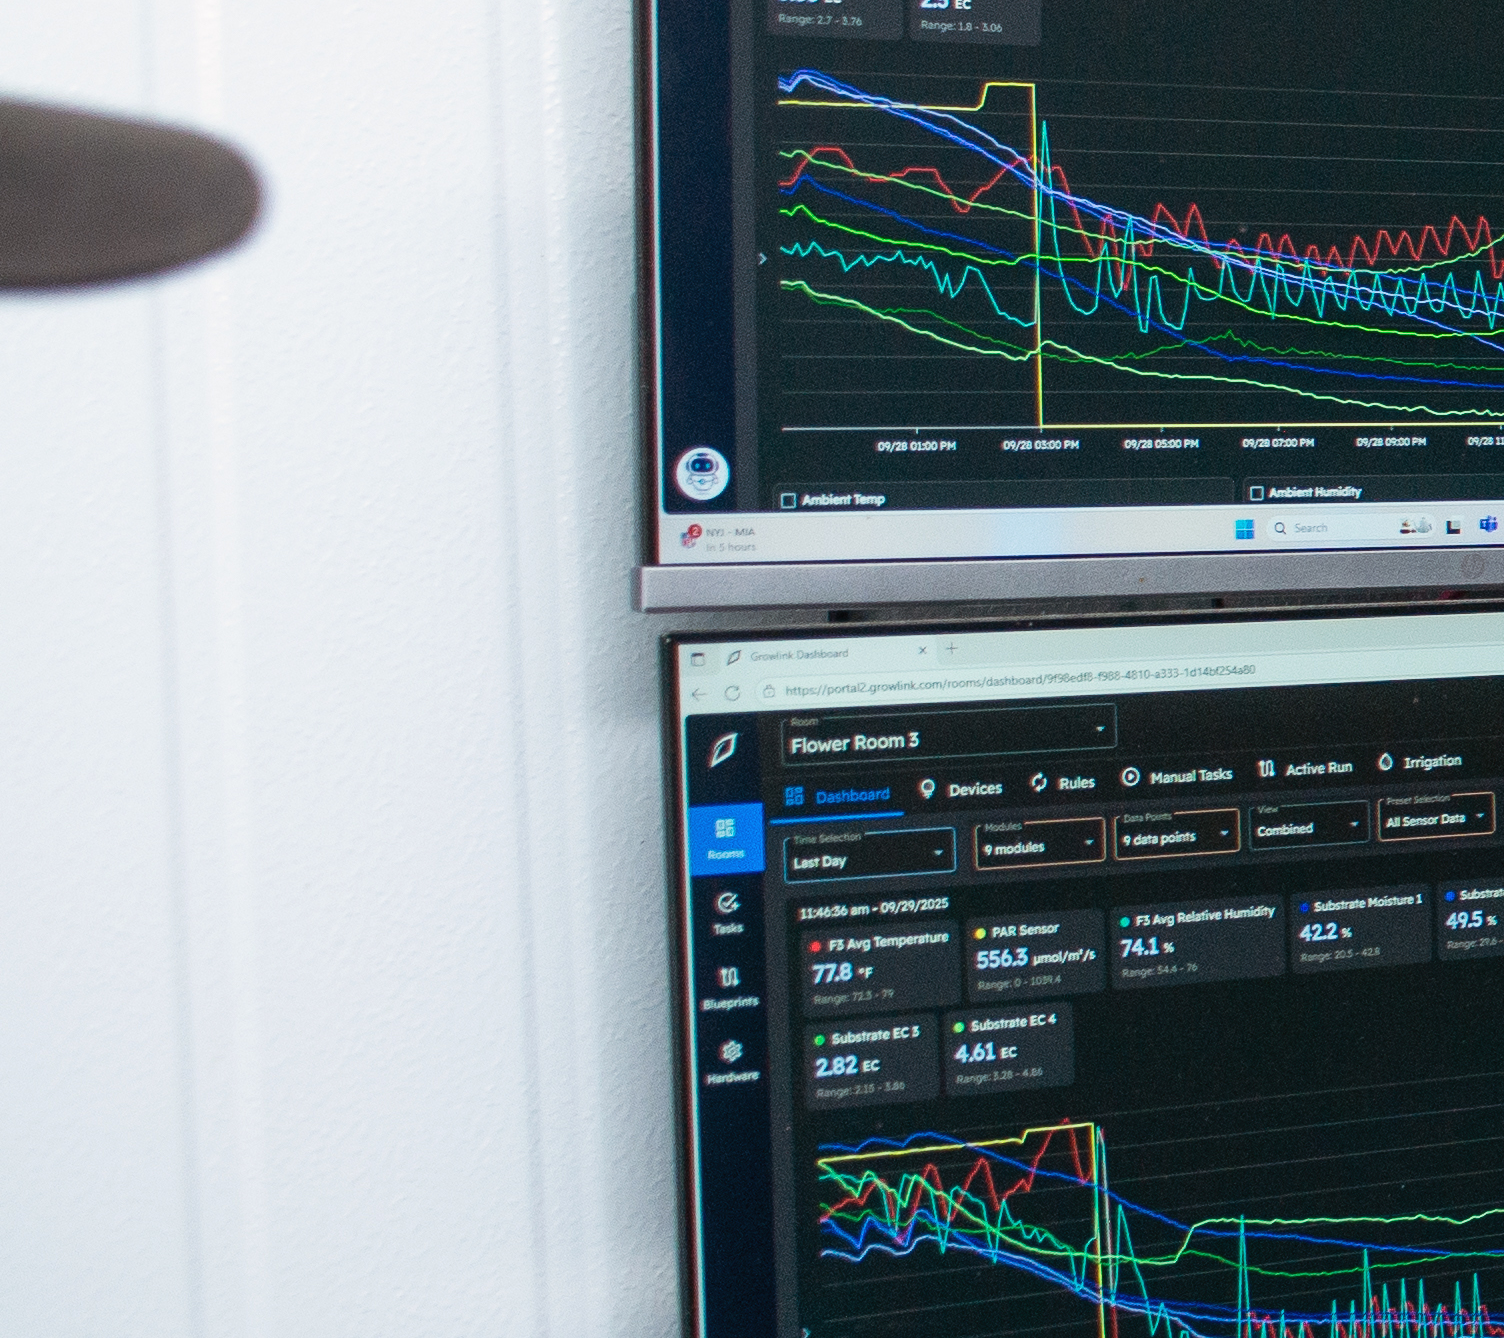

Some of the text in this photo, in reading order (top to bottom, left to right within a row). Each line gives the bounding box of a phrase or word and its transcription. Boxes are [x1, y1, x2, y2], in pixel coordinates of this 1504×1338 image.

[803, 493, 886, 507] Ambient Temp
[789, 732, 920, 754] Flower Room 3
[975, 947, 1028, 969] 556.3
[1120, 937, 1159, 957] 74.1
[811, 962, 853, 984] 77.8
